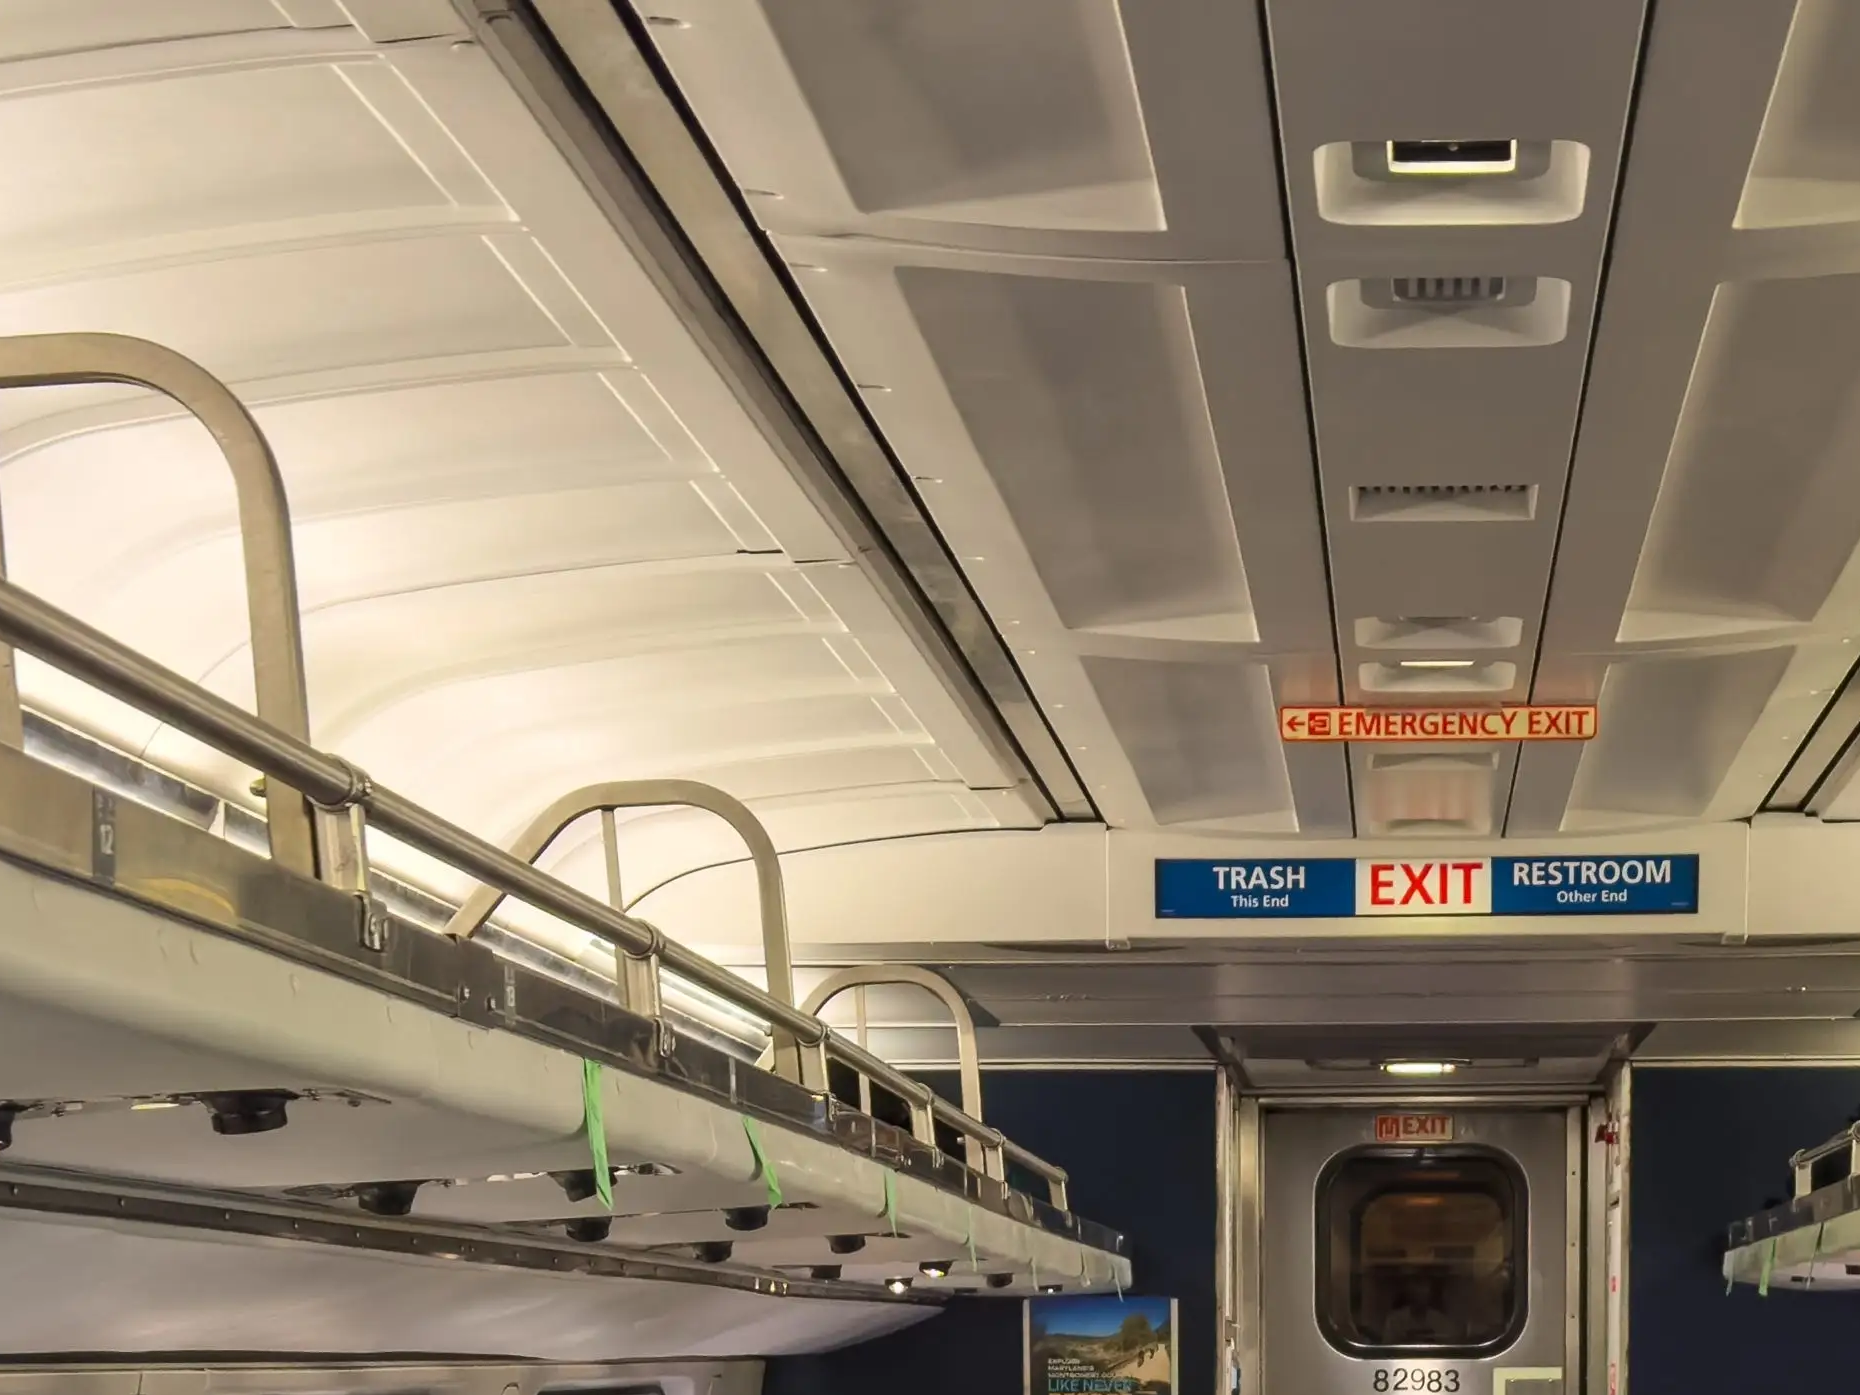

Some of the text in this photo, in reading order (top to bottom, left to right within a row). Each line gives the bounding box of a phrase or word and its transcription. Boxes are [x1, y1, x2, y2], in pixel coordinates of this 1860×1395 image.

[1339, 711, 1589, 736] EMERGENCY EXIT
[1213, 866, 1305, 889] TRASH
[1370, 863, 1483, 905] EXIT
[1513, 859, 1671, 886] RESTROOM
[1231, 894, 1289, 908] This End
[1556, 889, 1628, 903] Other End
[1402, 1116, 1449, 1134] EXIT
[1048, 1379, 1133, 1392] LIKE NEVER
[1373, 1368, 1460, 1393] 82983
